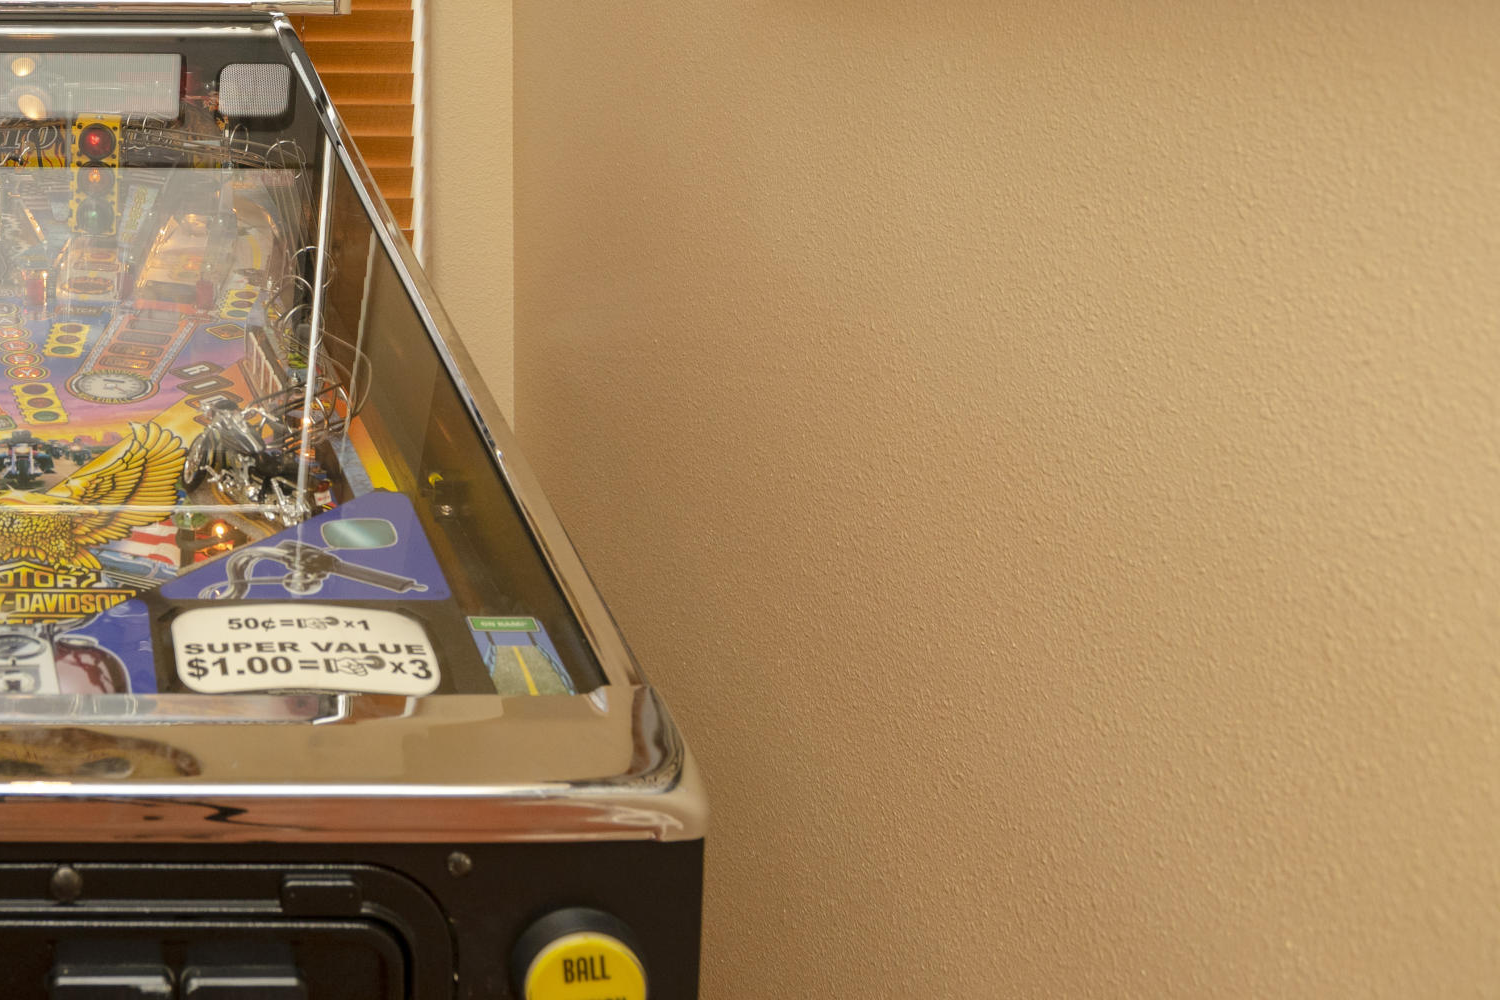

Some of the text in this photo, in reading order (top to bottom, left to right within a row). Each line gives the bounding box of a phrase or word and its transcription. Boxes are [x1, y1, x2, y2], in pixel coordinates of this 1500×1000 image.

[184, 641, 426, 655] SUPER VALUE
[562, 955, 611, 985] BALL
